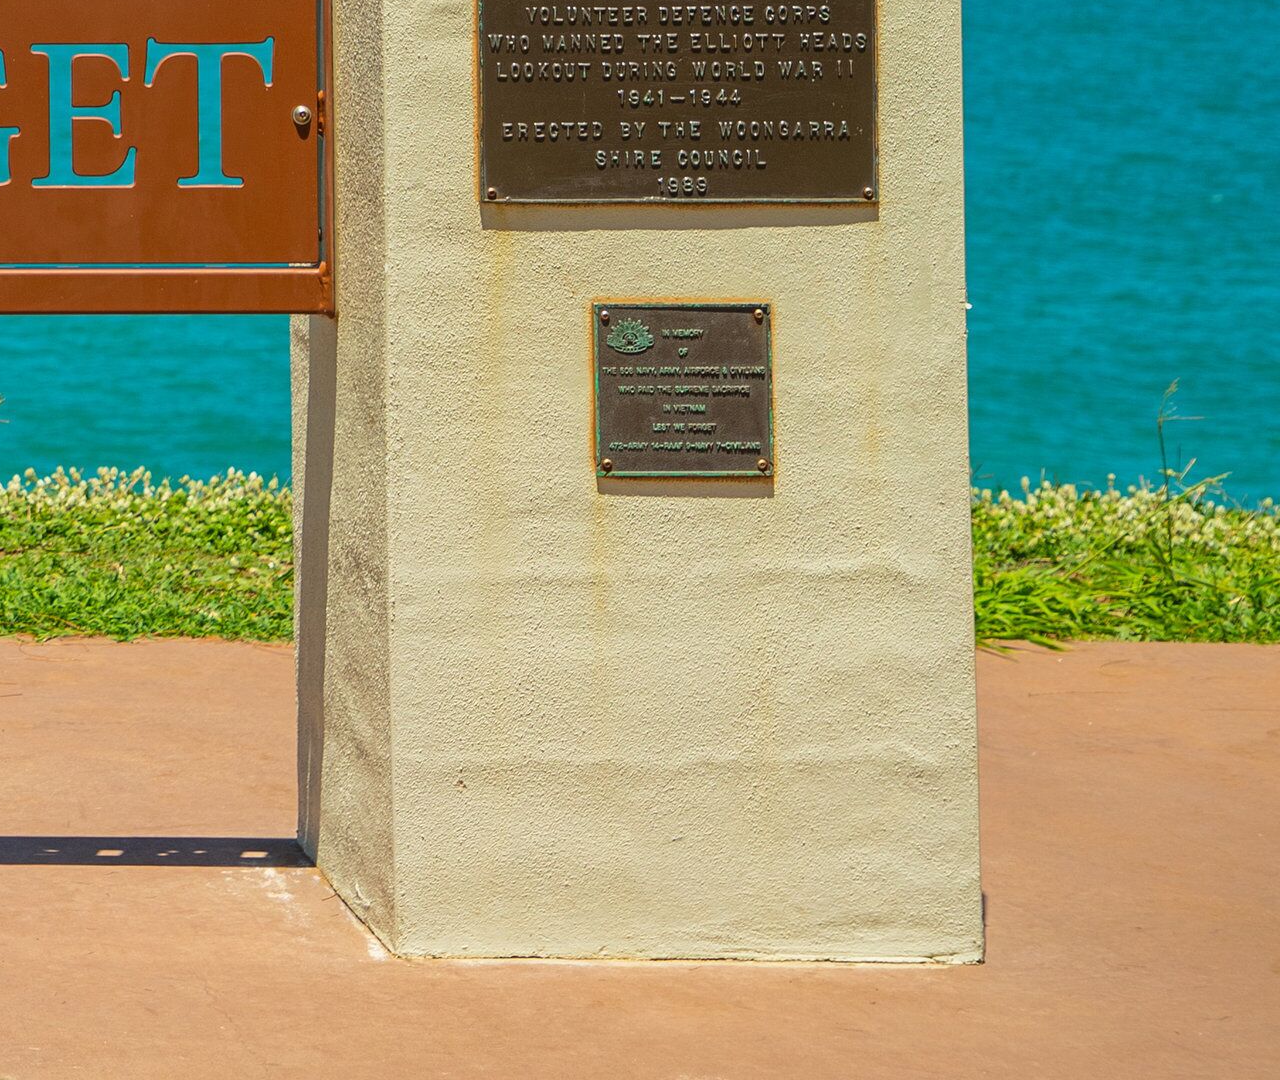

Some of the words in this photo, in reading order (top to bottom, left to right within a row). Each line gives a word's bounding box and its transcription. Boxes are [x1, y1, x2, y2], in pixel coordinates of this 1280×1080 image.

[526, 7, 647, 26] VOLUNTEER
[659, 6, 754, 23] DEFENCE
[765, 5, 831, 22] CORPS
[488, 34, 530, 53] WHO
[543, 34, 626, 52] MANNED
[637, 34, 678, 50] THE
[691, 33, 787, 50] ELLIOTT
[800, 33, 868, 50] HEADS
[497, 62, 591, 82] LOOKOUT
[602, 61, 677, 79] DURING
[692, 61, 765, 79] WORLD
[778, 60, 824, 78] WAR
[502, 123, 604, 141] ERECTED
[621, 122, 645, 139] BY
[658, 122, 702, 139] THE
[720, 121, 852, 140] WOONGARRA
[595, 151, 662, 168] SHIRE
[677, 150, 767, 168] COUNCIL
[657, 176, 708, 195] 1989
[662, 329, 669, 338] IN
[672, 329, 703, 338] MEMORY
[678, 348, 688, 357] OF
[602, 366, 616, 376] THE
[618, 386, 634, 394] WHO
[637, 385, 654, 394] PAID
[657, 386, 674, 394] THE
[675, 386, 709, 395] SUPREME
[712, 385, 750, 396] SACRIFICE
[663, 405, 671, 413] IN
[673, 404, 706, 413] VIETNAM
[652, 423, 671, 432] LEST
[673, 423, 685, 432] WE
[688, 423, 717, 433] FORGET
